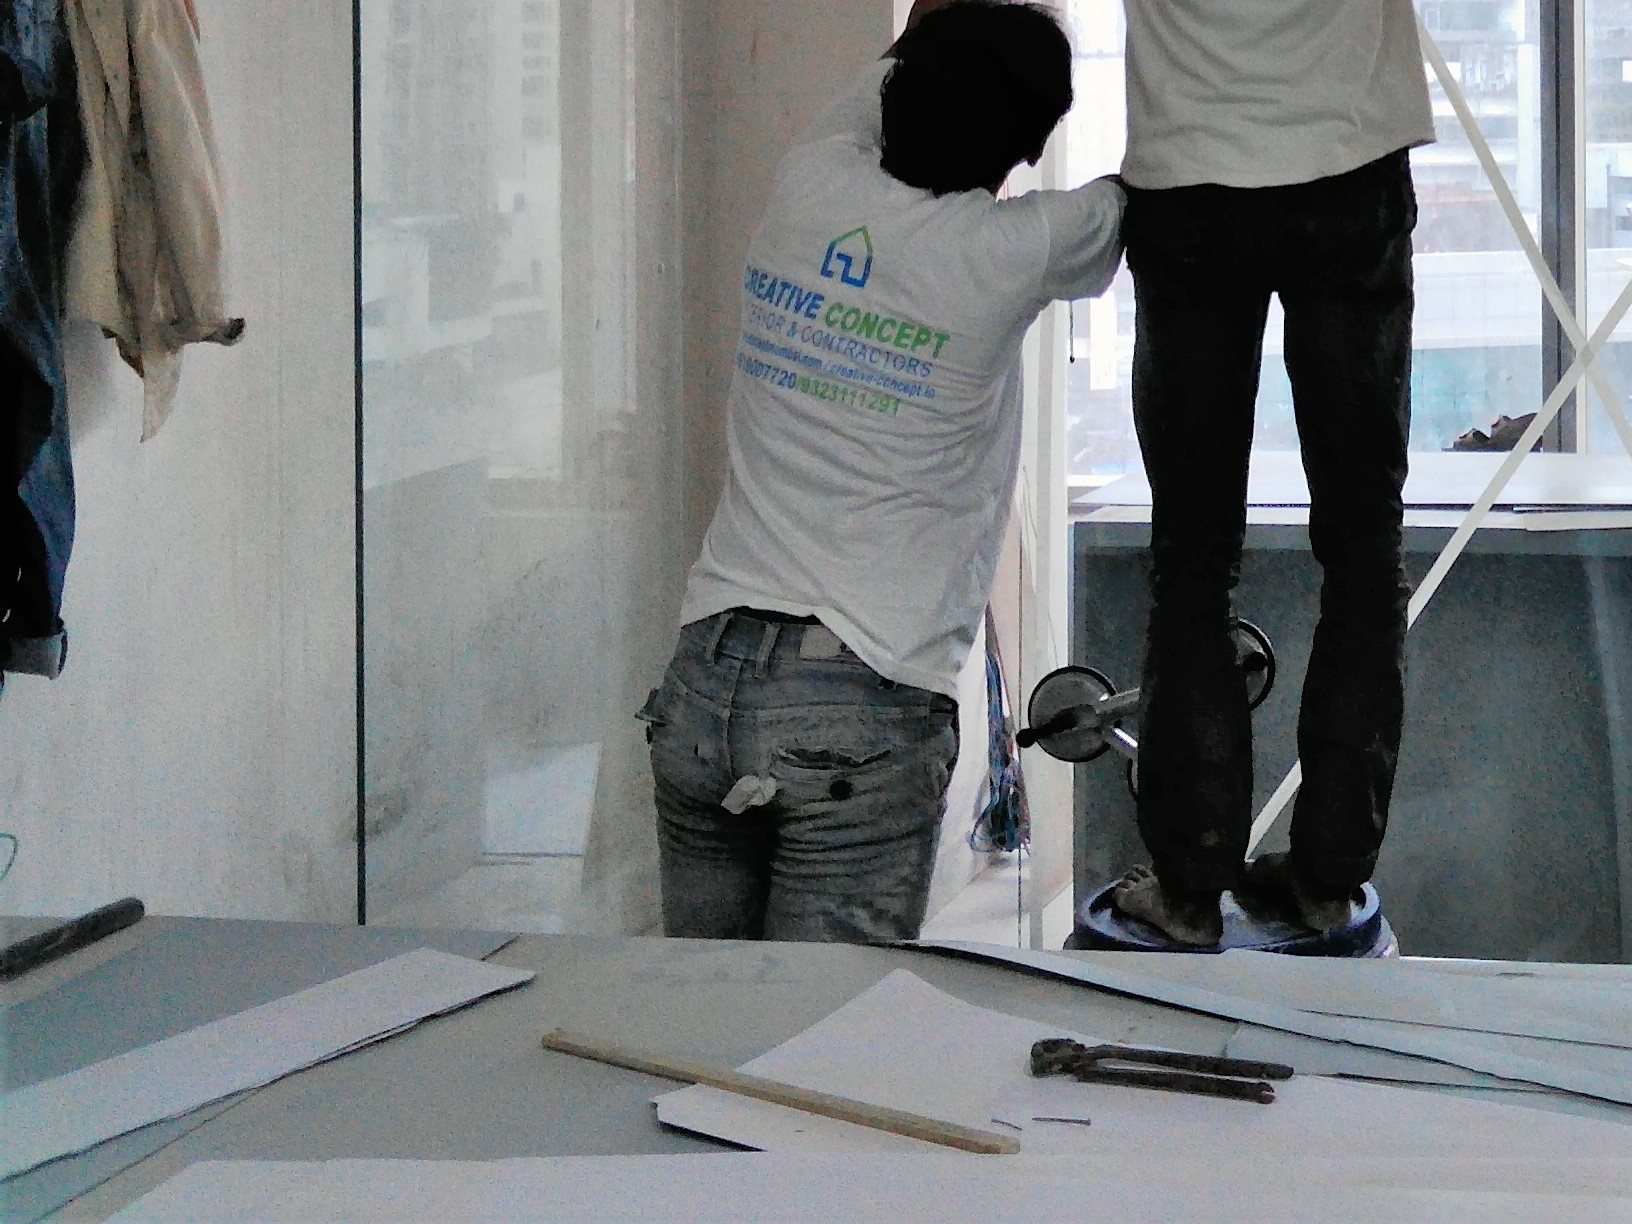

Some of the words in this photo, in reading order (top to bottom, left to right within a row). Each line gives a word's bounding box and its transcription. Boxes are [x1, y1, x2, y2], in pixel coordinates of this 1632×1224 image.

[786, 321, 798, 338] &
[801, 325, 934, 378] CONTRACTORS
[824, 301, 950, 359] CONCEPT
